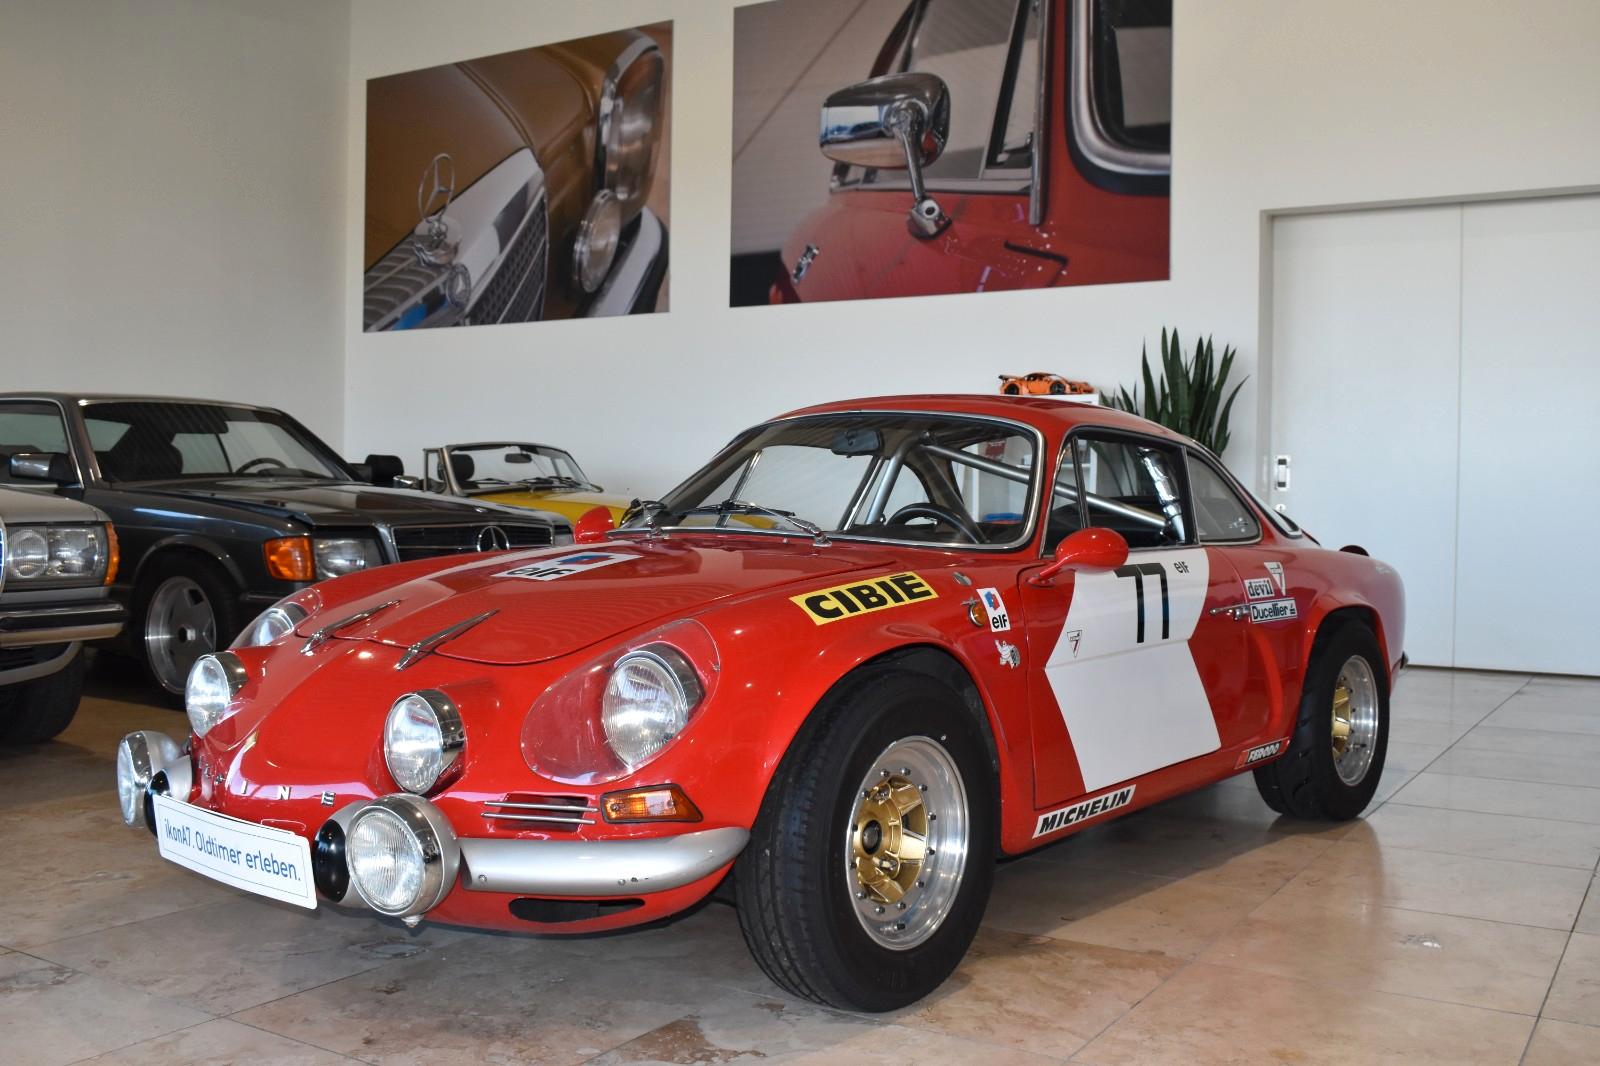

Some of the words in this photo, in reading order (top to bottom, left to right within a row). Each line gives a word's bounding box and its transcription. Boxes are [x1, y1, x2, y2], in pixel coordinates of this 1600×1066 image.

[506, 567, 576, 578] elf
[1173, 561, 1190, 573] elf
[1248, 580, 1273, 597] devil
[991, 614, 1008, 629] elf
[1038, 788, 1131, 834] MICHELIN
[195, 832, 242, 865] Oldtimer
[245, 850, 301, 881] erleben.
